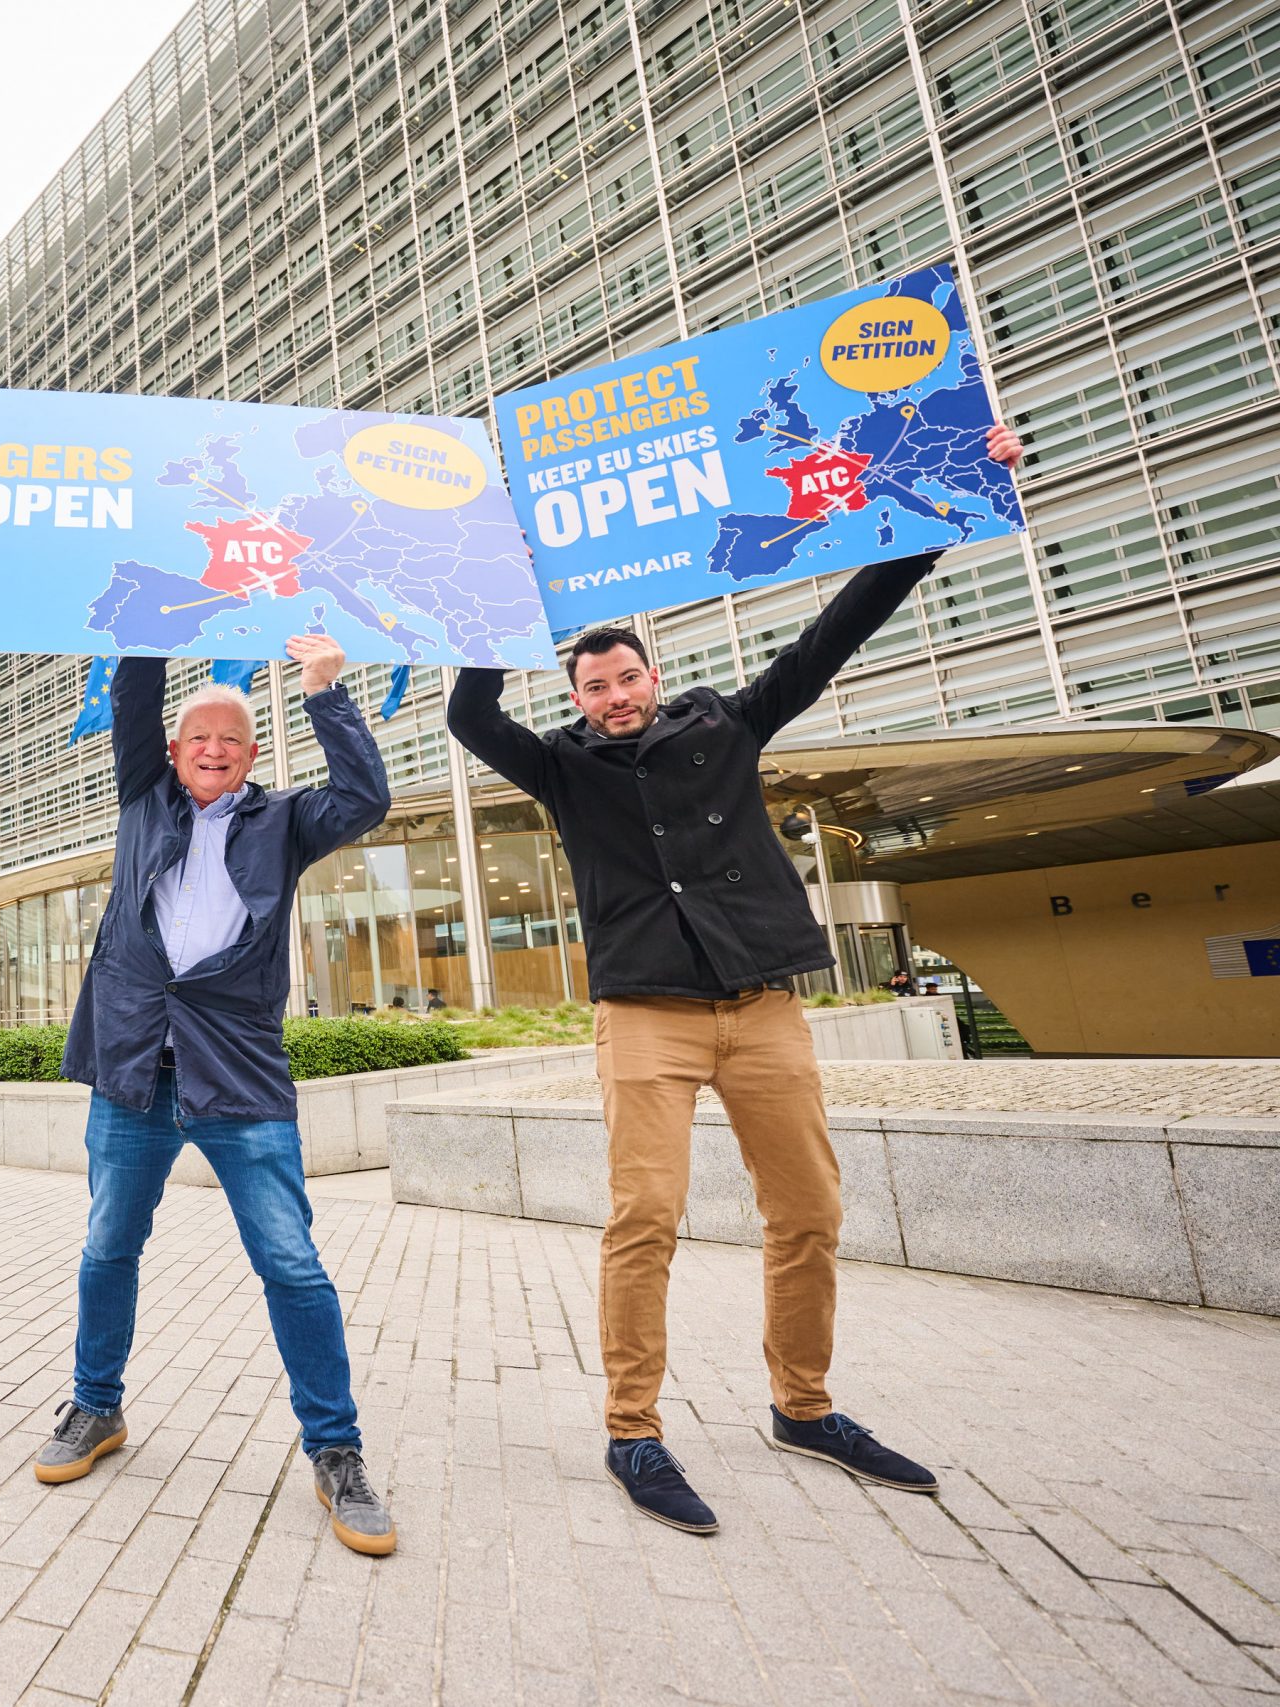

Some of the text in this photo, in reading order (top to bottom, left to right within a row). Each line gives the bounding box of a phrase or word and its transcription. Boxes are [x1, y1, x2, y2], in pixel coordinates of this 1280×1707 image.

[858, 319, 913, 339] SIGN
[831, 339, 936, 361] PETITION
[515, 356, 700, 437] PROTECT
[522, 390, 710, 462] PASSENGERS
[355, 451, 472, 489] PETITION
[386, 440, 447, 465] SIGN
[528, 425, 718, 494] KEEP EU SKIES
[533, 449, 732, 548] OPEN
[800, 466, 851, 495] ATC
[223, 539, 283, 564] ATC
[568, 550, 692, 592] RYANAIR
